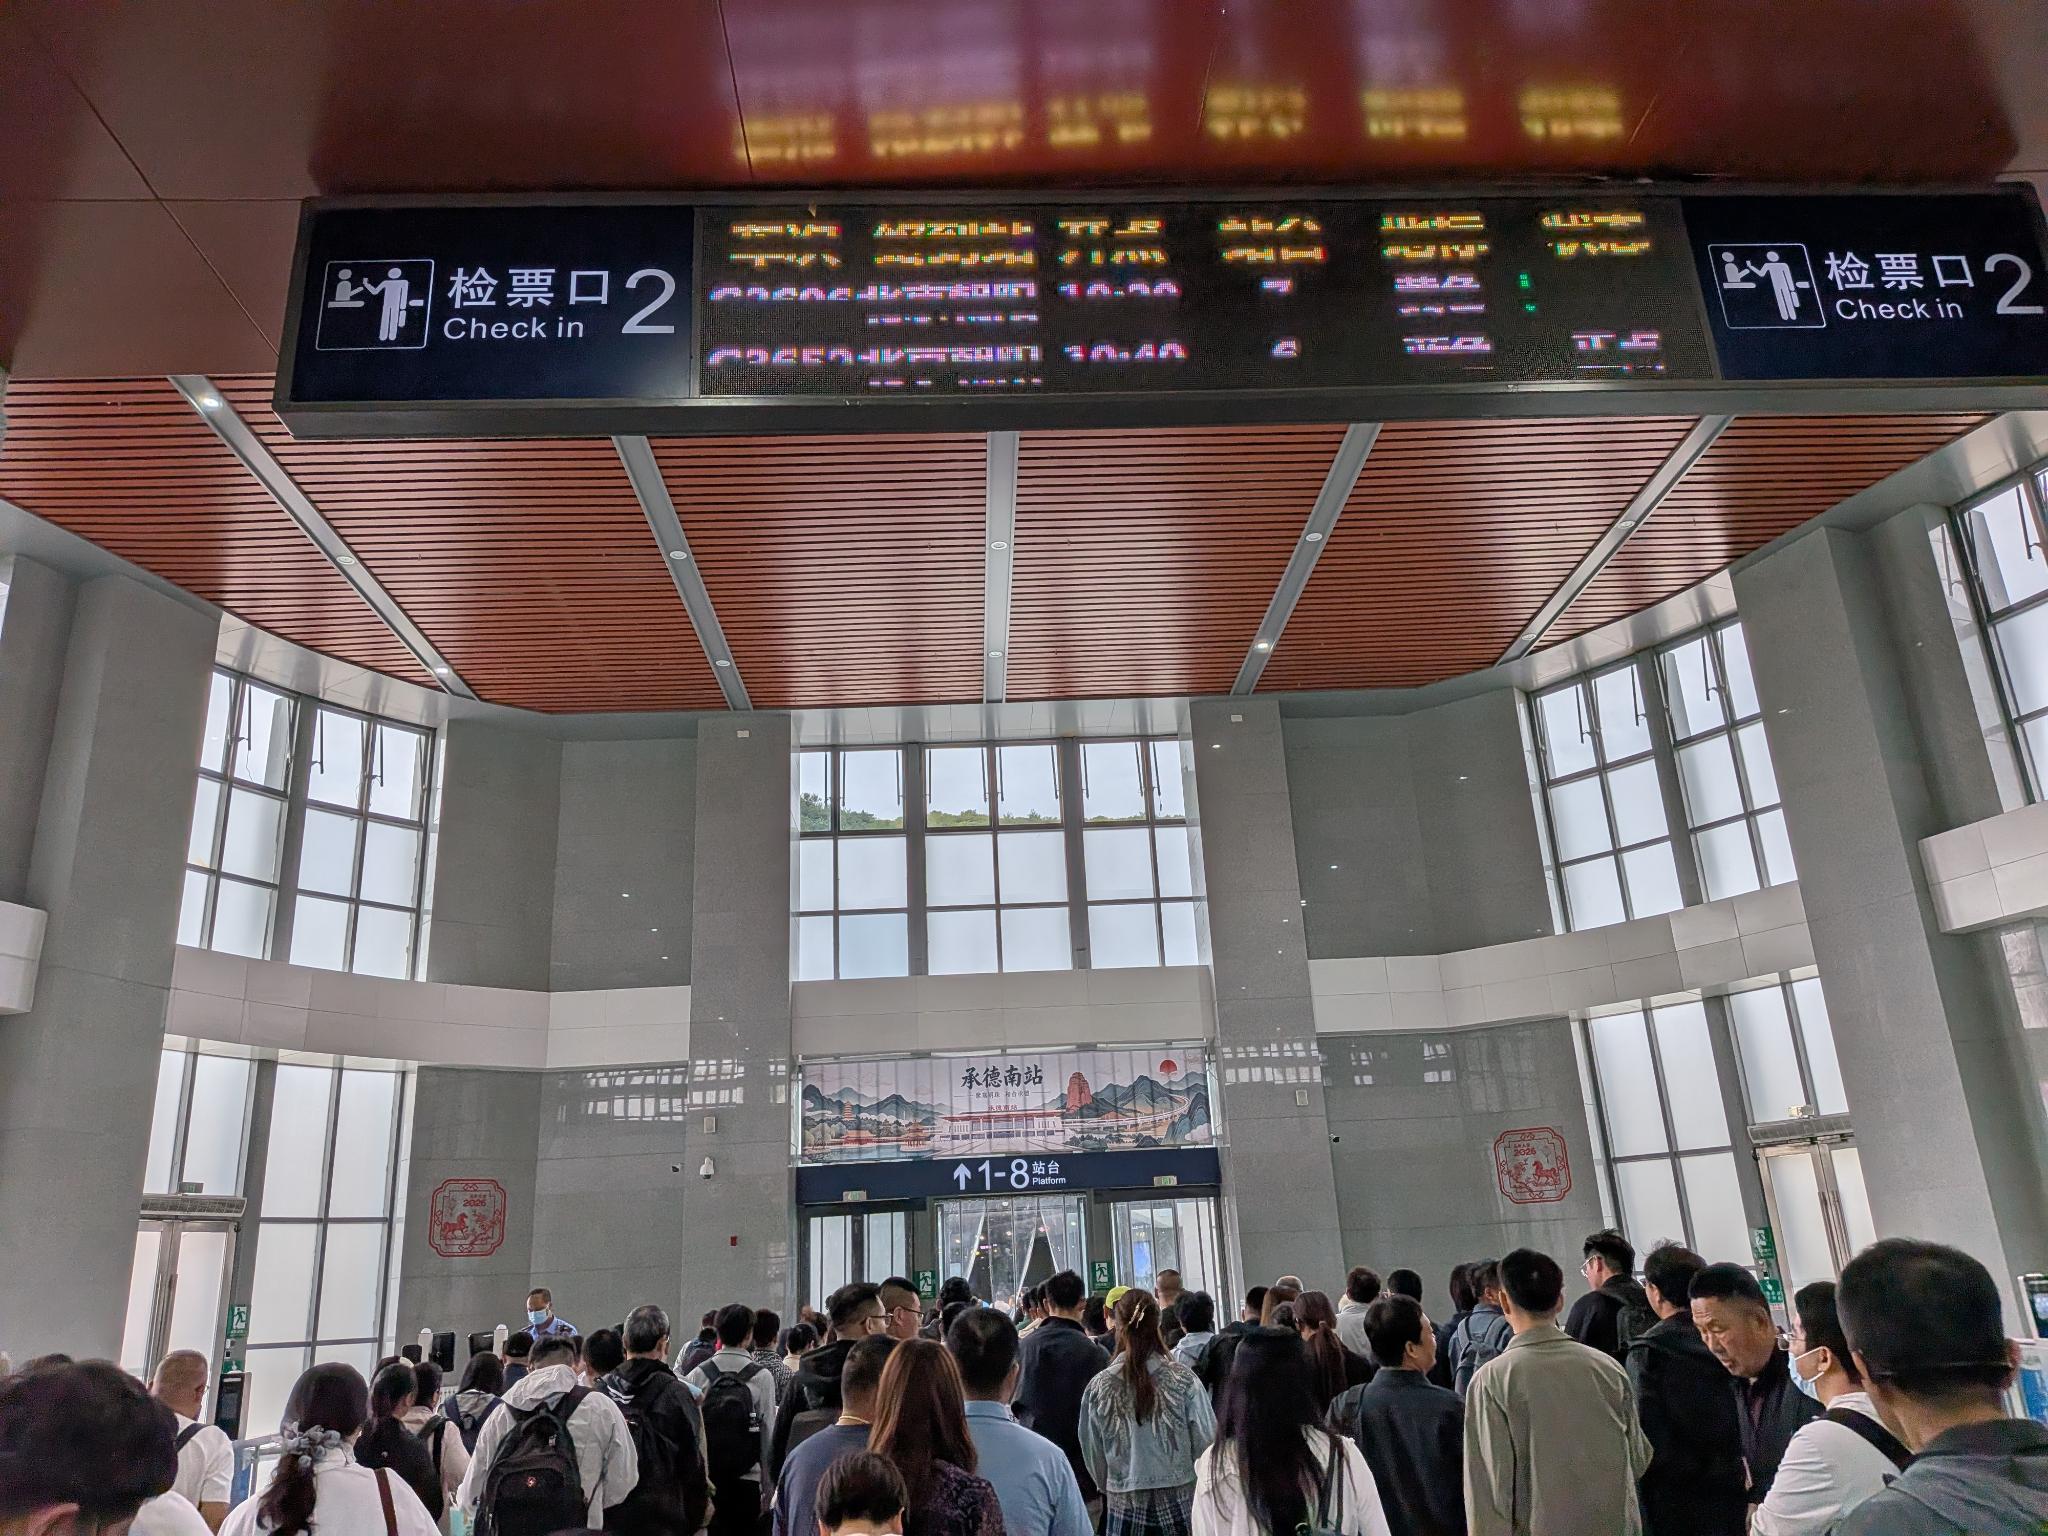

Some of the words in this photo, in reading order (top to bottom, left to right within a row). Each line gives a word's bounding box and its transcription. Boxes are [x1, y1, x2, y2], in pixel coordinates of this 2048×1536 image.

[1825, 251, 1975, 290] 检票口
[448, 267, 609, 308] 检票口
[1985, 253, 2045, 315] 2
[621, 268, 676, 334] 2
[1835, 298, 1930, 320] Check
[1937, 298, 1963, 319] in
[444, 316, 547, 339] Check
[557, 316, 584, 338] in
[961, 1064, 1043, 1089] 承德南站
[1513, 1148, 1537, 1156] 2026
[978, 1159, 1030, 1191] 1-8
[1032, 1160, 1059, 1175] 站台
[1032, 1177, 1066, 1186] Platform
[463, 1199, 487, 1207] 2026
